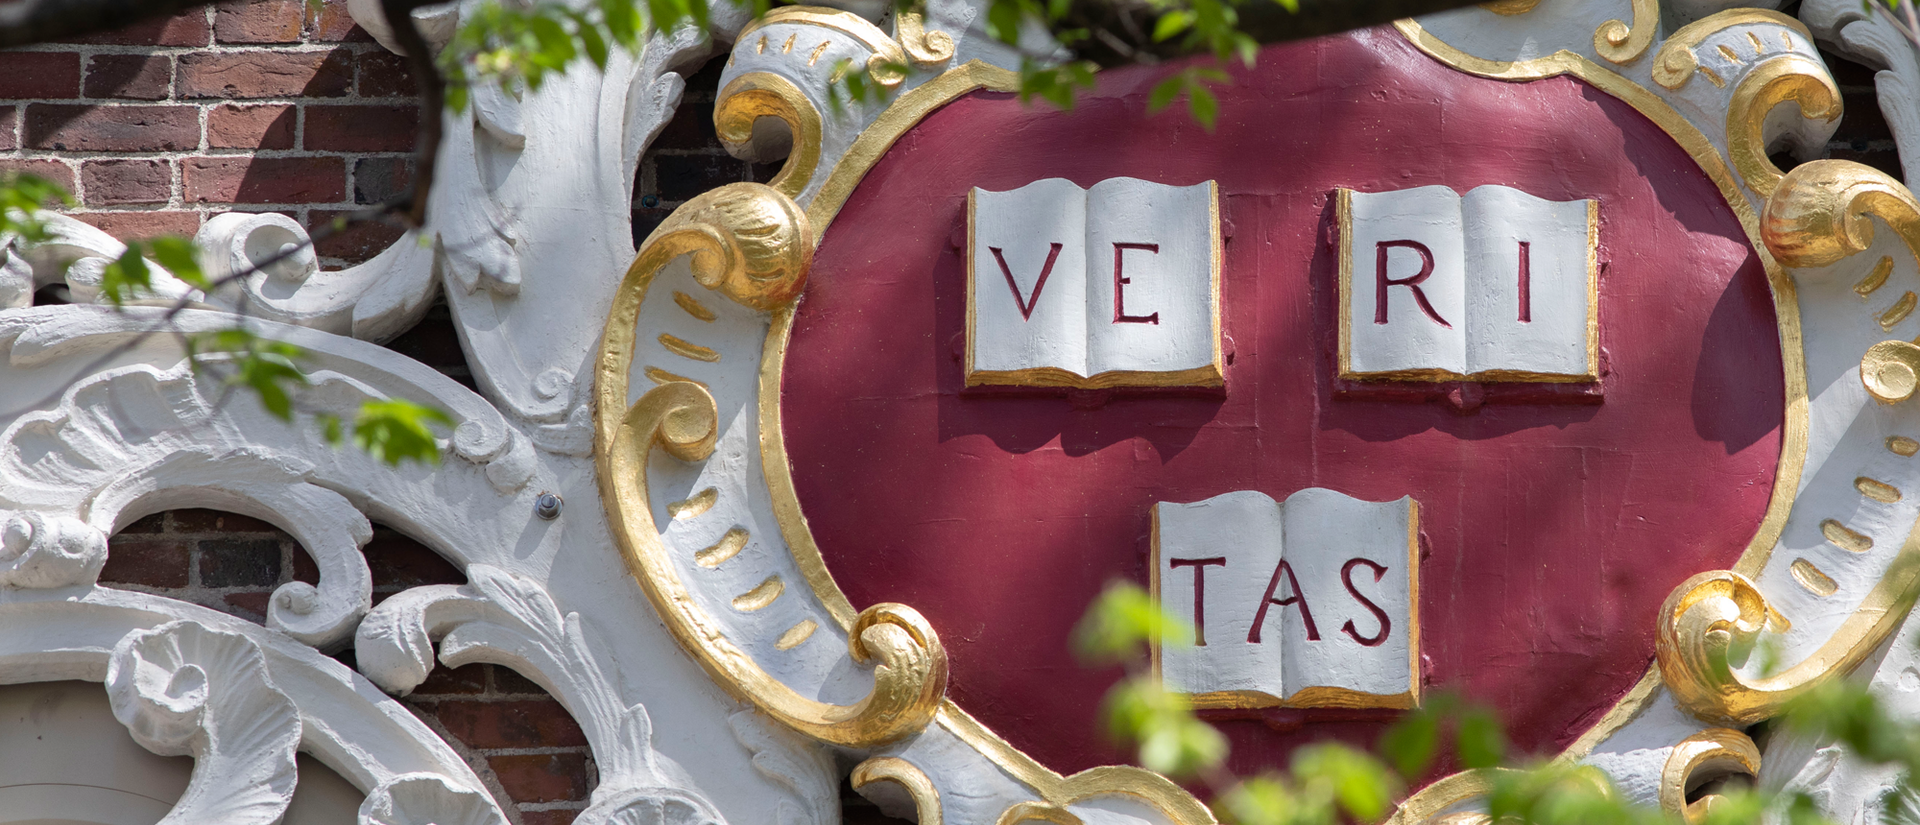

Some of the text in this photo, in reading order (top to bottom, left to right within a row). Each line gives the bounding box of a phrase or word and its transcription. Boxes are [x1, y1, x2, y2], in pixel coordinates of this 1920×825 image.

[988, 242, 1159, 325] VE
[1374, 239, 1532, 328] RI
[1170, 556, 1391, 647] TAS
